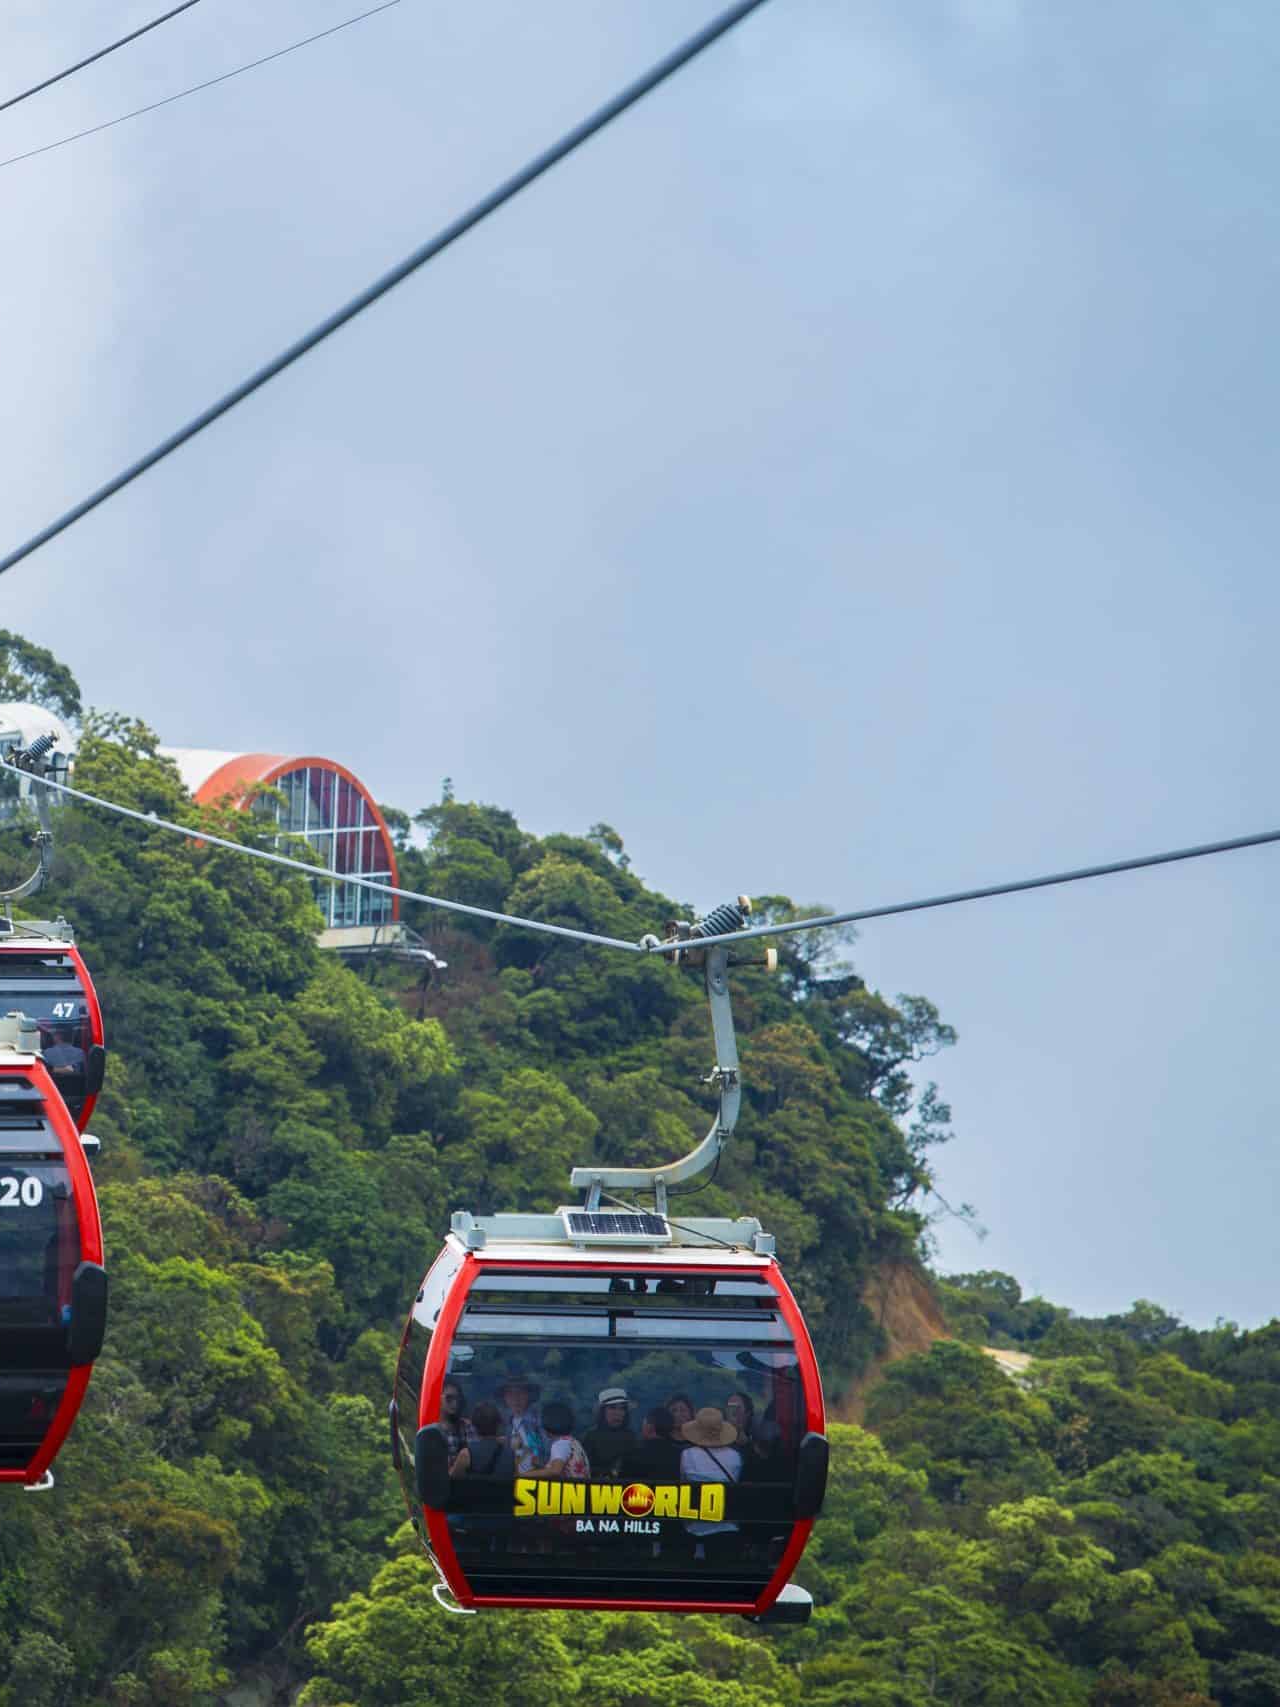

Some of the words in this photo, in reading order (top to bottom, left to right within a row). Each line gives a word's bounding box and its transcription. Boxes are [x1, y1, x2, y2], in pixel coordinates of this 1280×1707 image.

[51, 1002, 75, 1018] 47
[0, 1176, 43, 1208] 20
[514, 1478, 586, 1517] SUN
[590, 1482, 726, 1522] WORLD
[575, 1519, 595, 1532] BA
[598, 1519, 620, 1533] NA
[624, 1519, 661, 1534] HILLS
